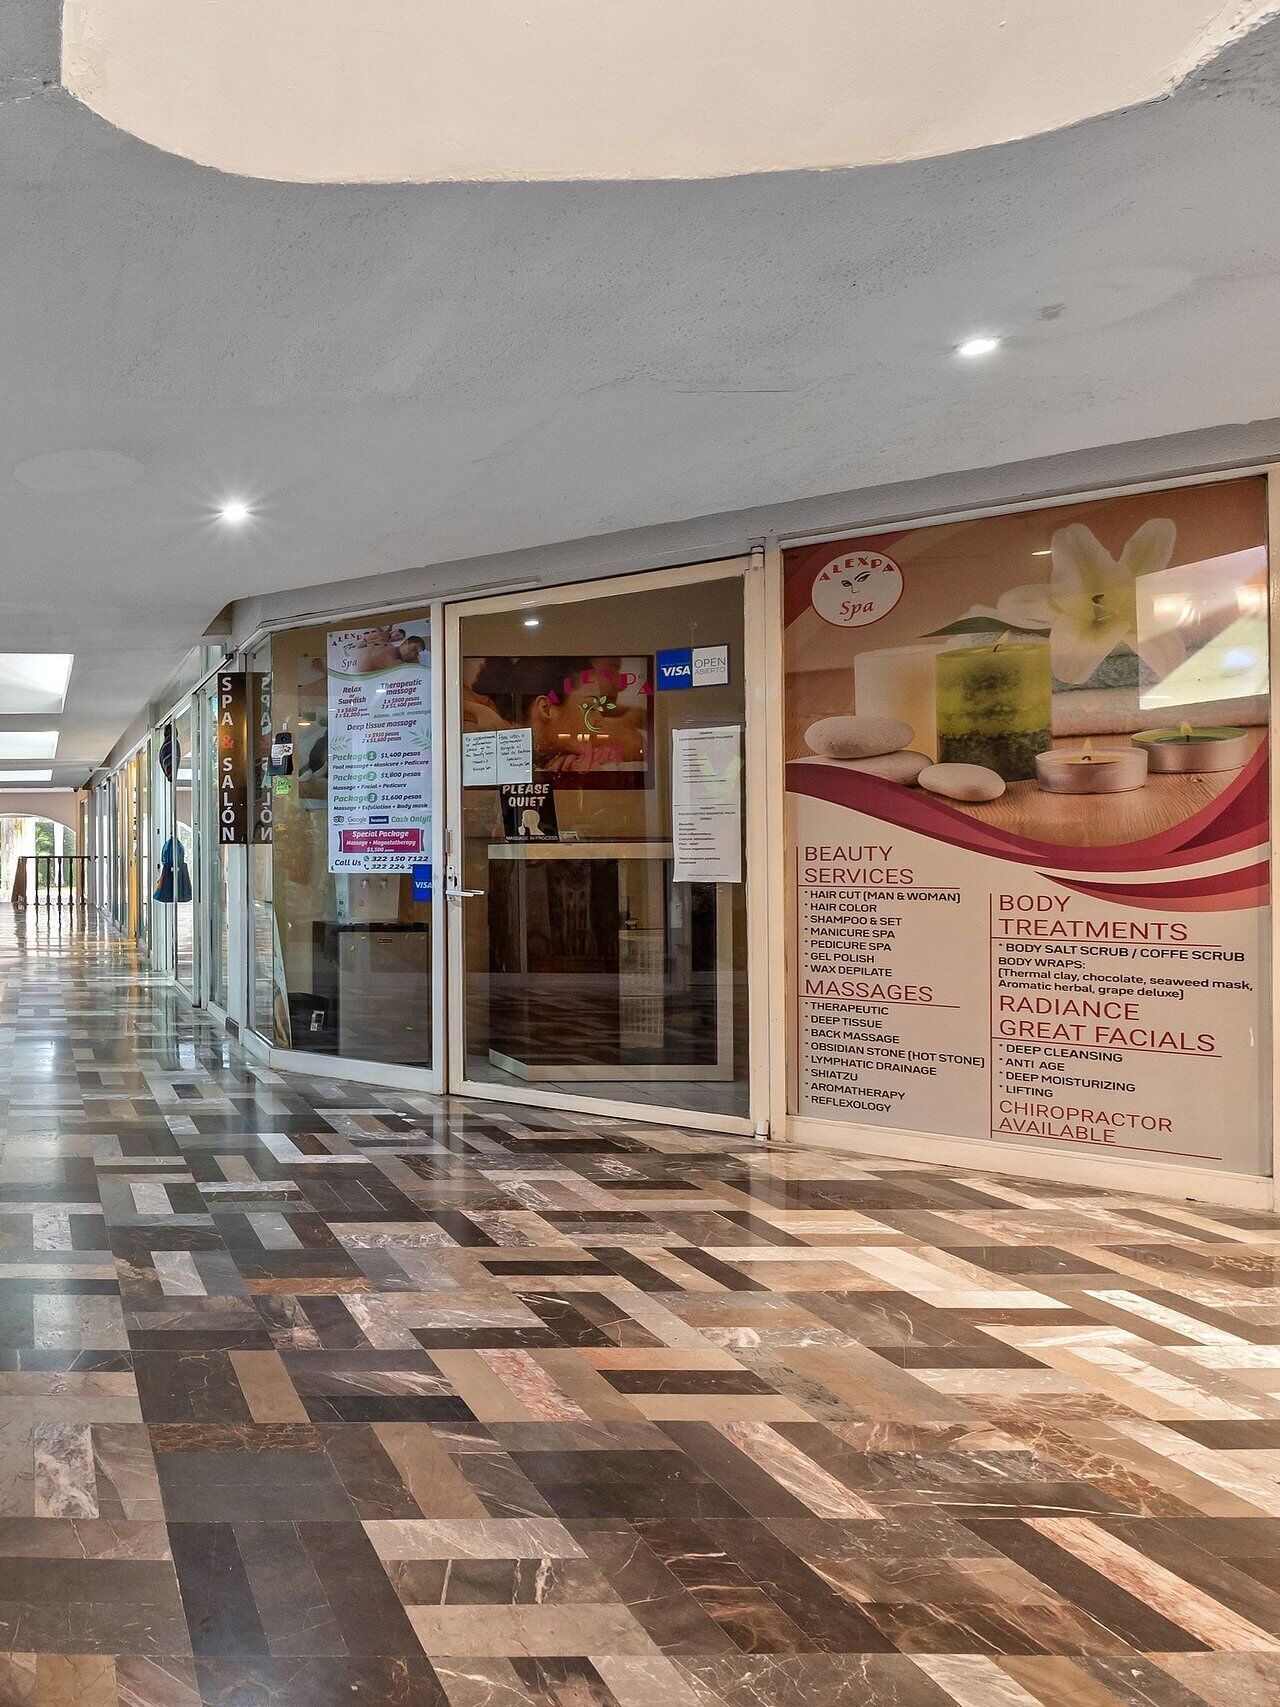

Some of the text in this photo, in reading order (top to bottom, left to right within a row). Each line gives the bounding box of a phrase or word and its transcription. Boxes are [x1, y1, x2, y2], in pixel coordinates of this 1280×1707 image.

[819, 557, 894, 581] ALEXPA
[840, 601, 874, 621] Spa
[342, 659, 357, 671] Spa
[695, 657, 726, 668] OPEN
[661, 666, 691, 676] VISA
[695, 667, 725, 675] ABIERTO
[386, 687, 417, 695] massage
[221, 735, 234, 748] &
[502, 784, 549, 794] PLEASE
[509, 797, 545, 807] QUIET
[805, 846, 893, 861] BEAUTY
[805, 868, 913, 884] SERVICES
[811, 891, 837, 899] HAIR
[839, 891, 861, 899] CUT
[811, 903, 877, 912] HAIR COLOR
[999, 894, 1071, 912] BODY
[811, 915, 902, 926] SHAMPOO & SET
[811, 928, 895, 938] MANICURE SPA
[999, 919, 1187, 941] TREATMENTS
[811, 940, 892, 951] PEDICURE SPA
[1006, 943, 1245, 962] BODY SALT SCRUB / COFFE SCRUB
[811, 953, 875, 963] GEL POLISH
[999, 957, 1086, 969] BODY WRAPS:
[811, 965, 892, 977] WAX DEPILATE
[999, 980, 1052, 991] Aromatic
[1054, 982, 1095, 994] herbal,
[1098, 985, 1134, 996] grape
[1054, 971, 1080, 982] clay,
[1083, 973, 1146, 985] chocolate,
[1150, 977, 1209, 988] seaweed
[1212, 980, 1253, 991] mask,
[806, 980, 933, 1002] MASSAGES
[811, 1002, 889, 1015] THERAPEUTIC
[1000, 996, 1139, 1020] RADIANCE
[811, 1015, 882, 1028] DEEP TISSUE
[811, 1029, 899, 1044] BACK MASSAGE
[999, 1019, 1215, 1052] GREAT FACIALS
[811, 1042, 864, 1054] OBSIDIAN
[867, 1047, 905, 1058] STONE
[1006, 1044, 1123, 1063] DEEP CLEANSING
[811, 1055, 937, 1075] LYMPHATIC DRAINAGE
[1006, 1059, 1065, 1071] ANTI AGE
[811, 1069, 858, 1081] SHIATZU
[1006, 1072, 1136, 1092] DEEP MOISTURIZING
[811, 1082, 905, 1100] AROMATHERAPY
[1006, 1085, 1053, 1098] LIFTING
[811, 1095, 891, 1112] REFLEXOLOGY
[999, 1100, 1173, 1133] CHIROPRACTOR
[999, 1117, 1115, 1144] AVAILABLE
